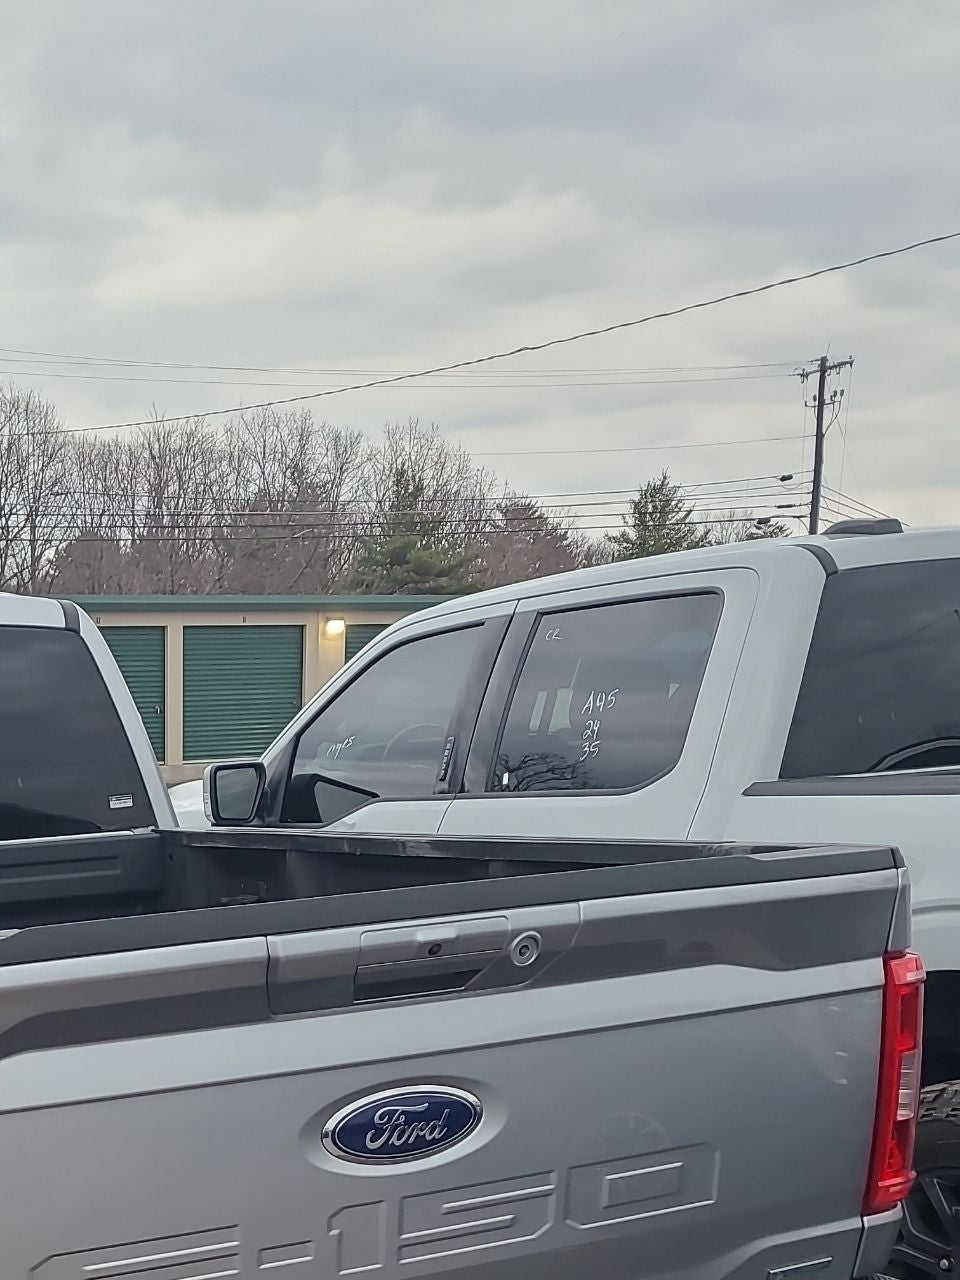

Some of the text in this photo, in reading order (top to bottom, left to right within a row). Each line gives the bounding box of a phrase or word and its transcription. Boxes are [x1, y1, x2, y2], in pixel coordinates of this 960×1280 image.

[581, 688, 620, 715] A45
[582, 719, 601, 741] 24
[579, 740, 601, 762] 35
[365, 1102, 451, 1150] Ford
